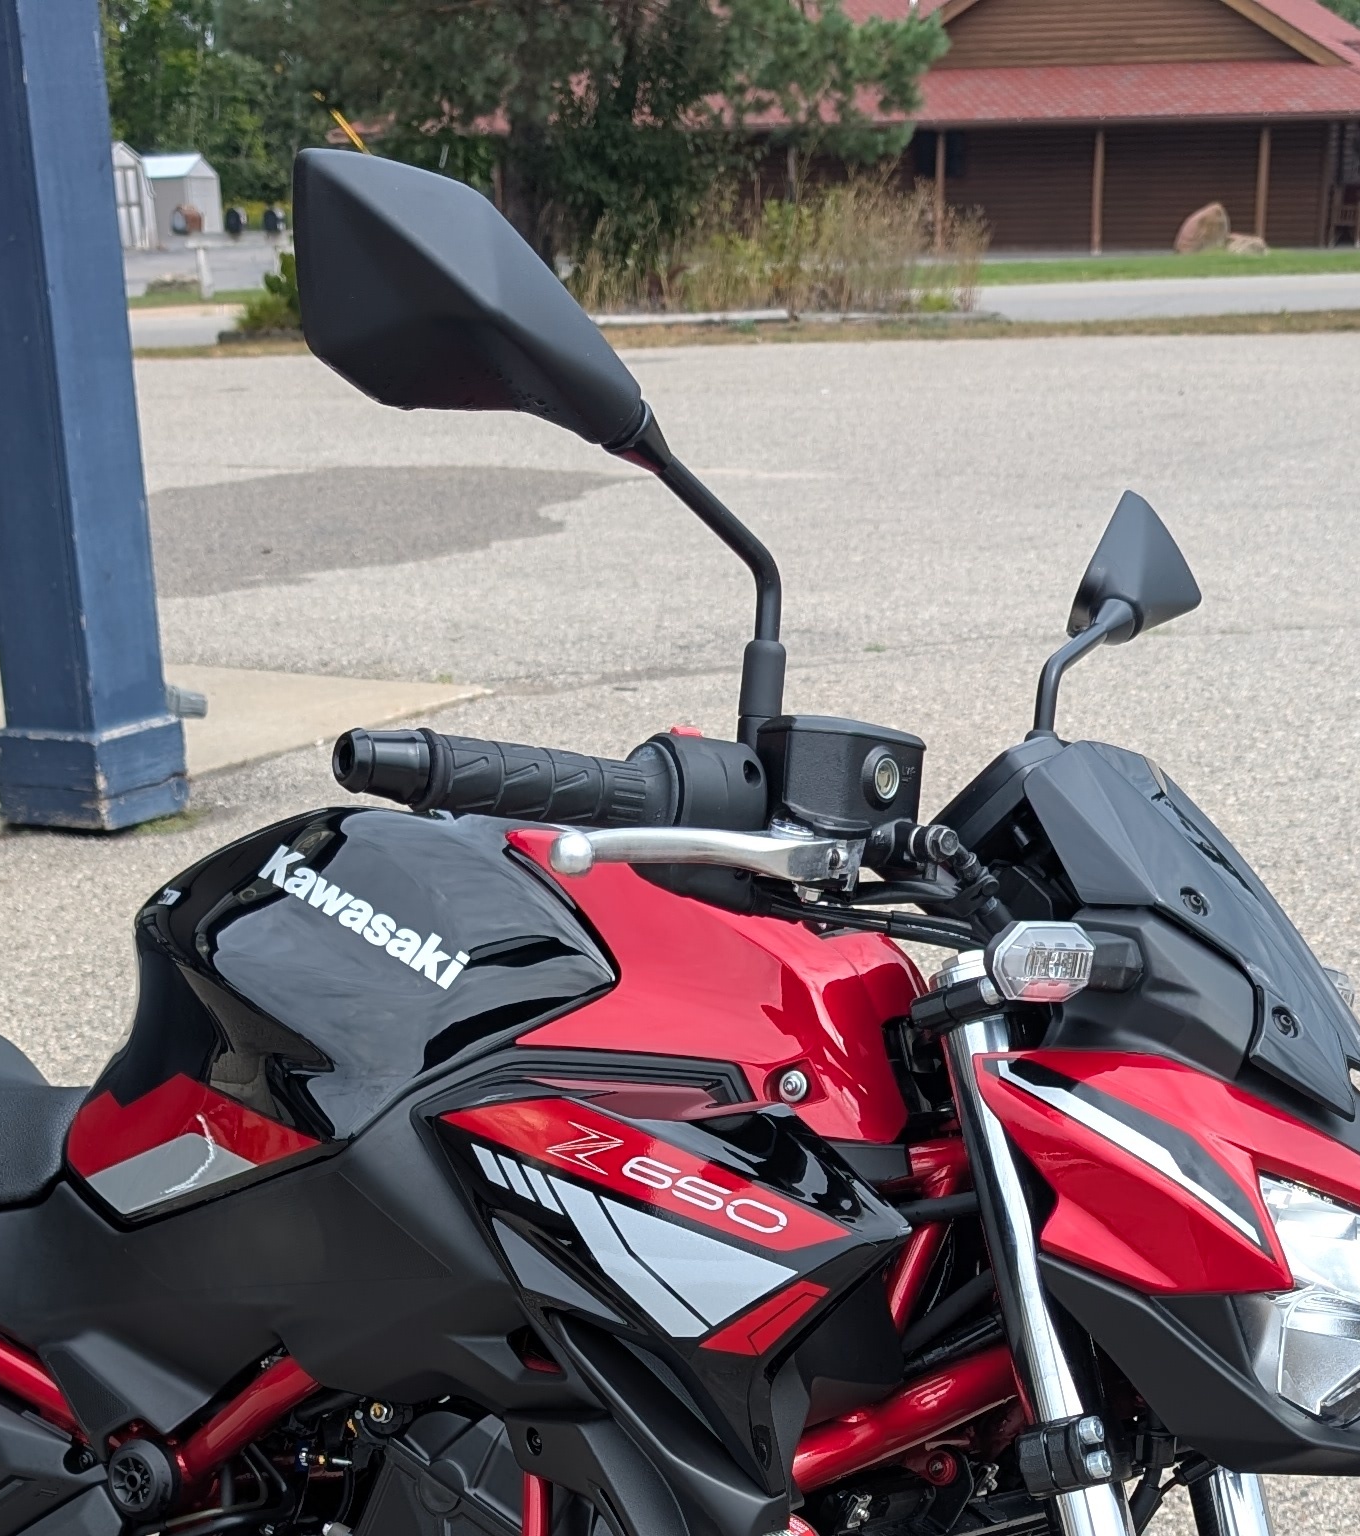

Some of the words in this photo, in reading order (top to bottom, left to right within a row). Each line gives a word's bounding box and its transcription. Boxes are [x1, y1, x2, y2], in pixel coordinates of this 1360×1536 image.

[257, 845, 470, 990] Kawasaki
[546, 1120, 625, 1176] Z
[620, 1156, 788, 1235] 650
